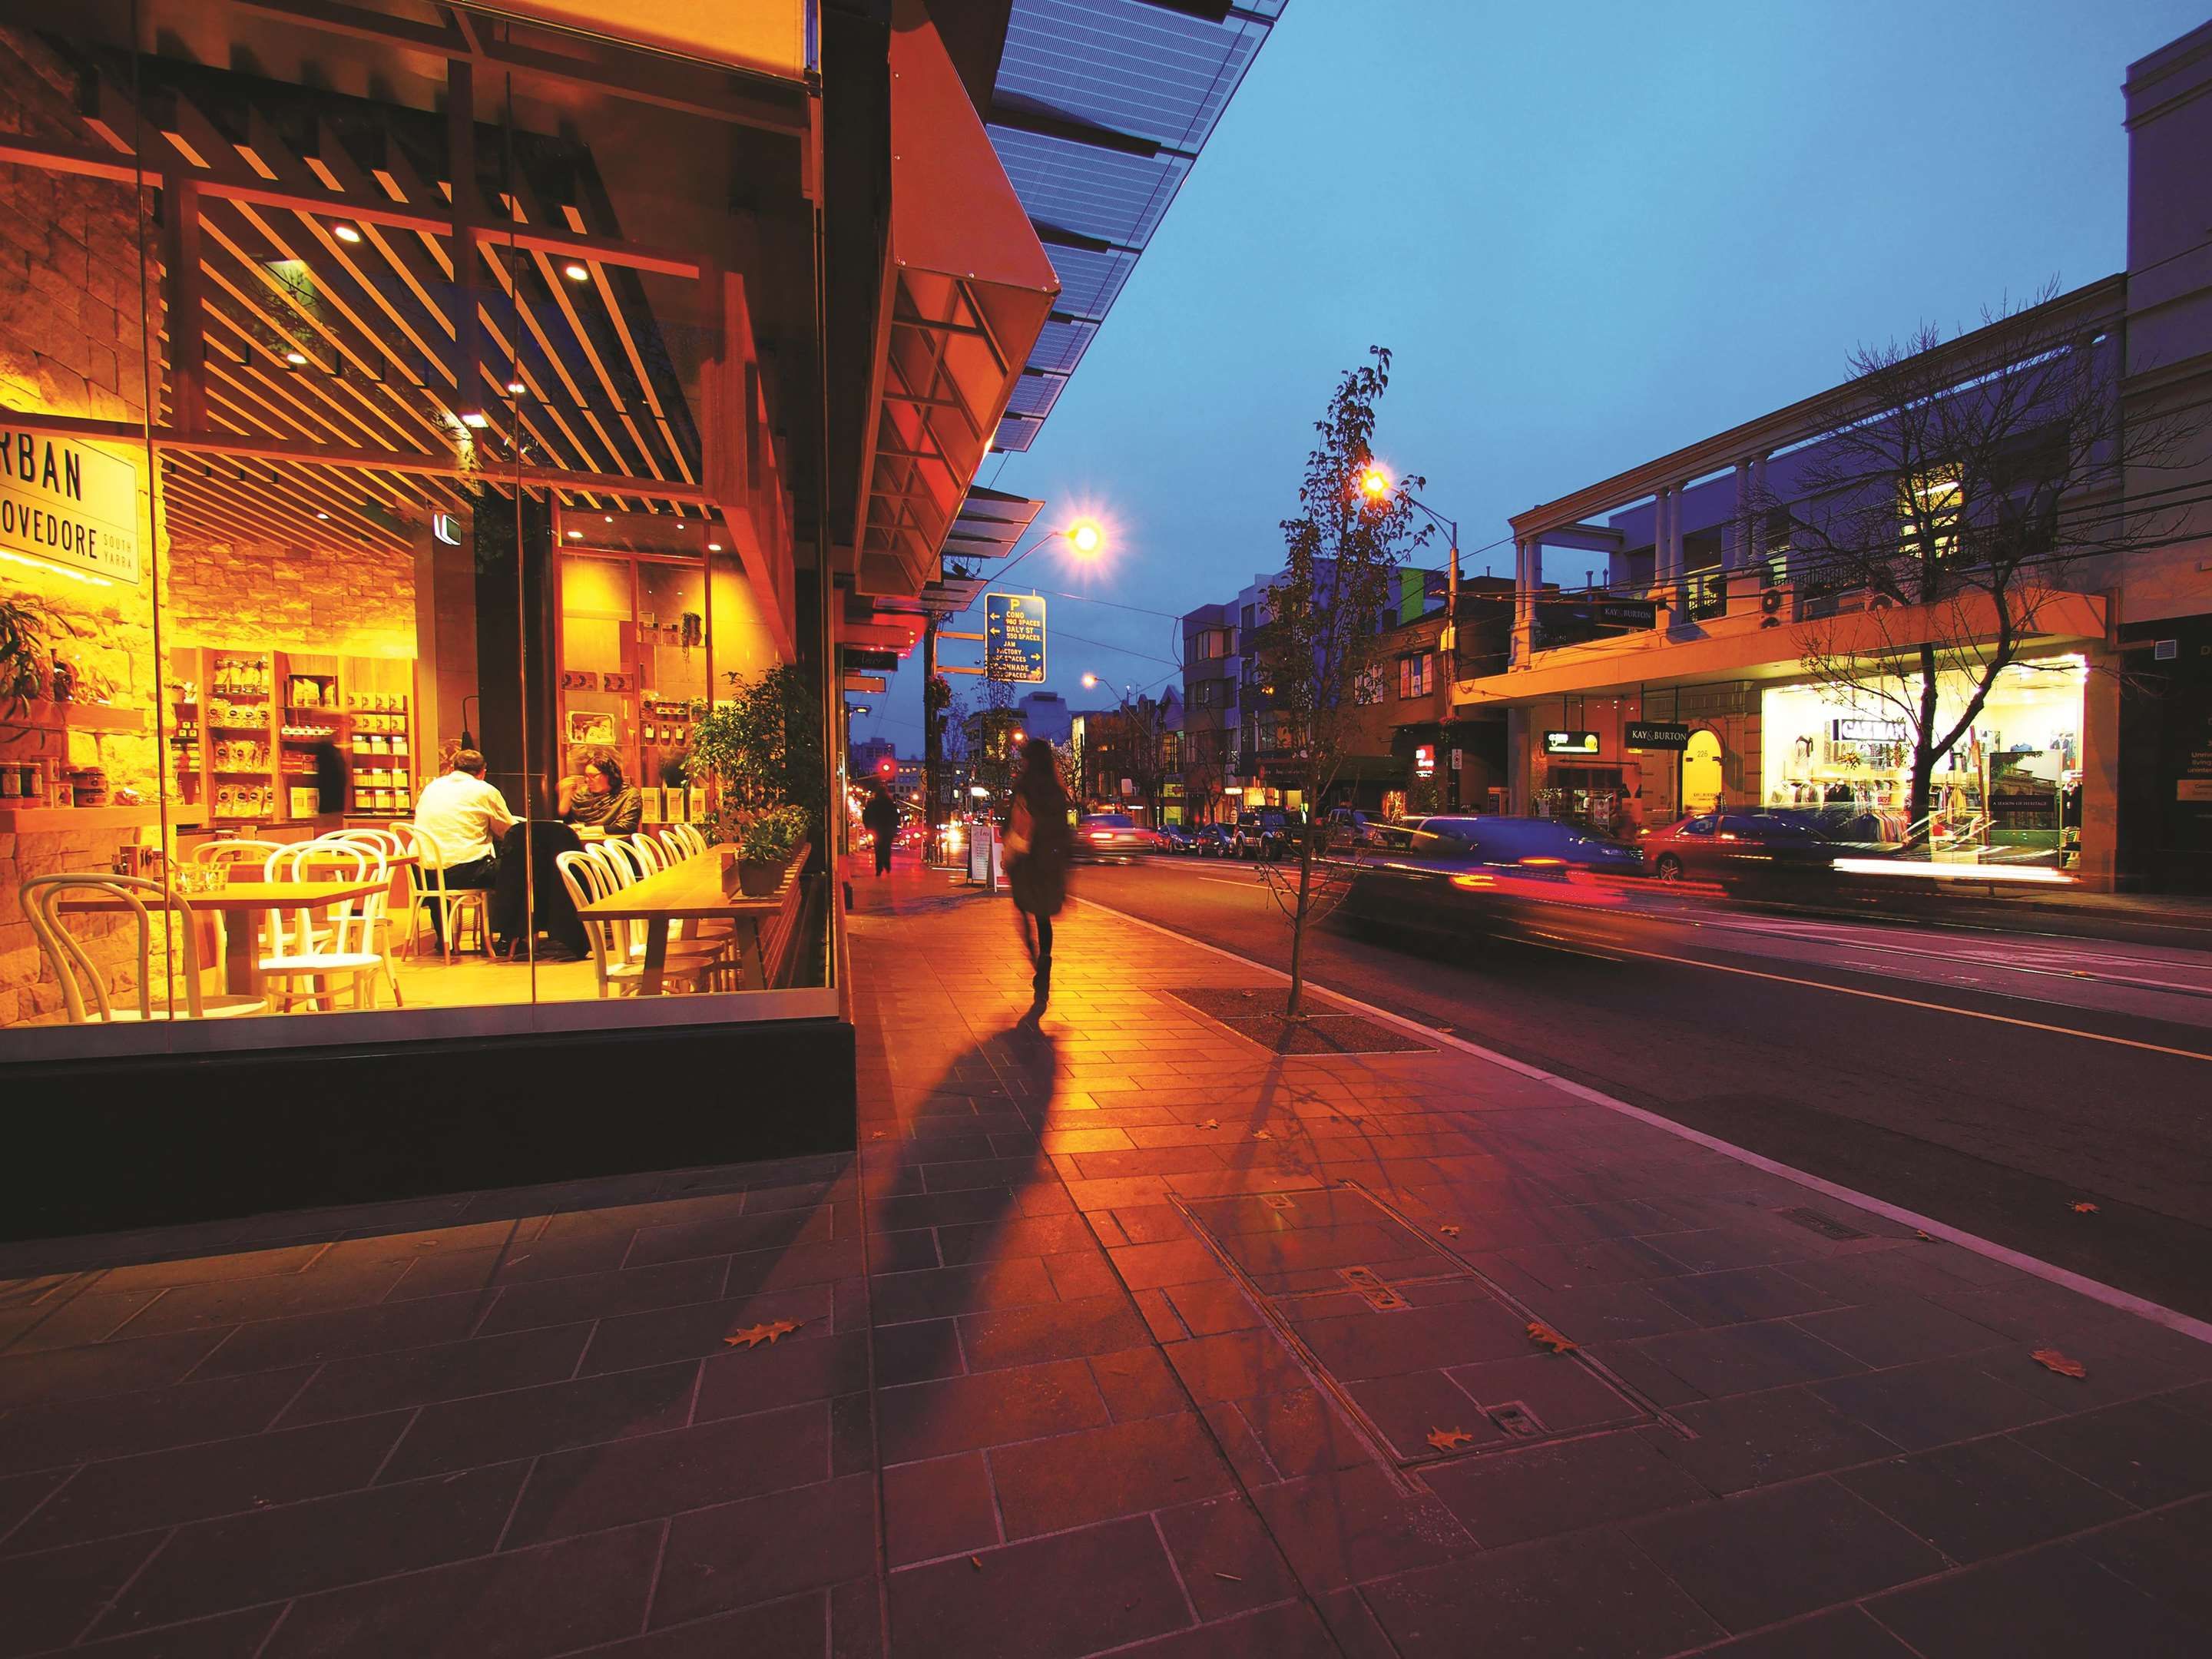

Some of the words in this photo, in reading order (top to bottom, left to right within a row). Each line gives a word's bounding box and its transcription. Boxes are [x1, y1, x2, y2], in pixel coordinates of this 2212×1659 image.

[104, 533, 131, 553] SOUTH
[104, 550, 132, 570] YARRA
[1011, 598, 1020, 610] P
[1623, 608, 1651, 618] BURTON
[1632, 730, 1647, 739] KAY
[1654, 731, 1687, 741] BURTON
